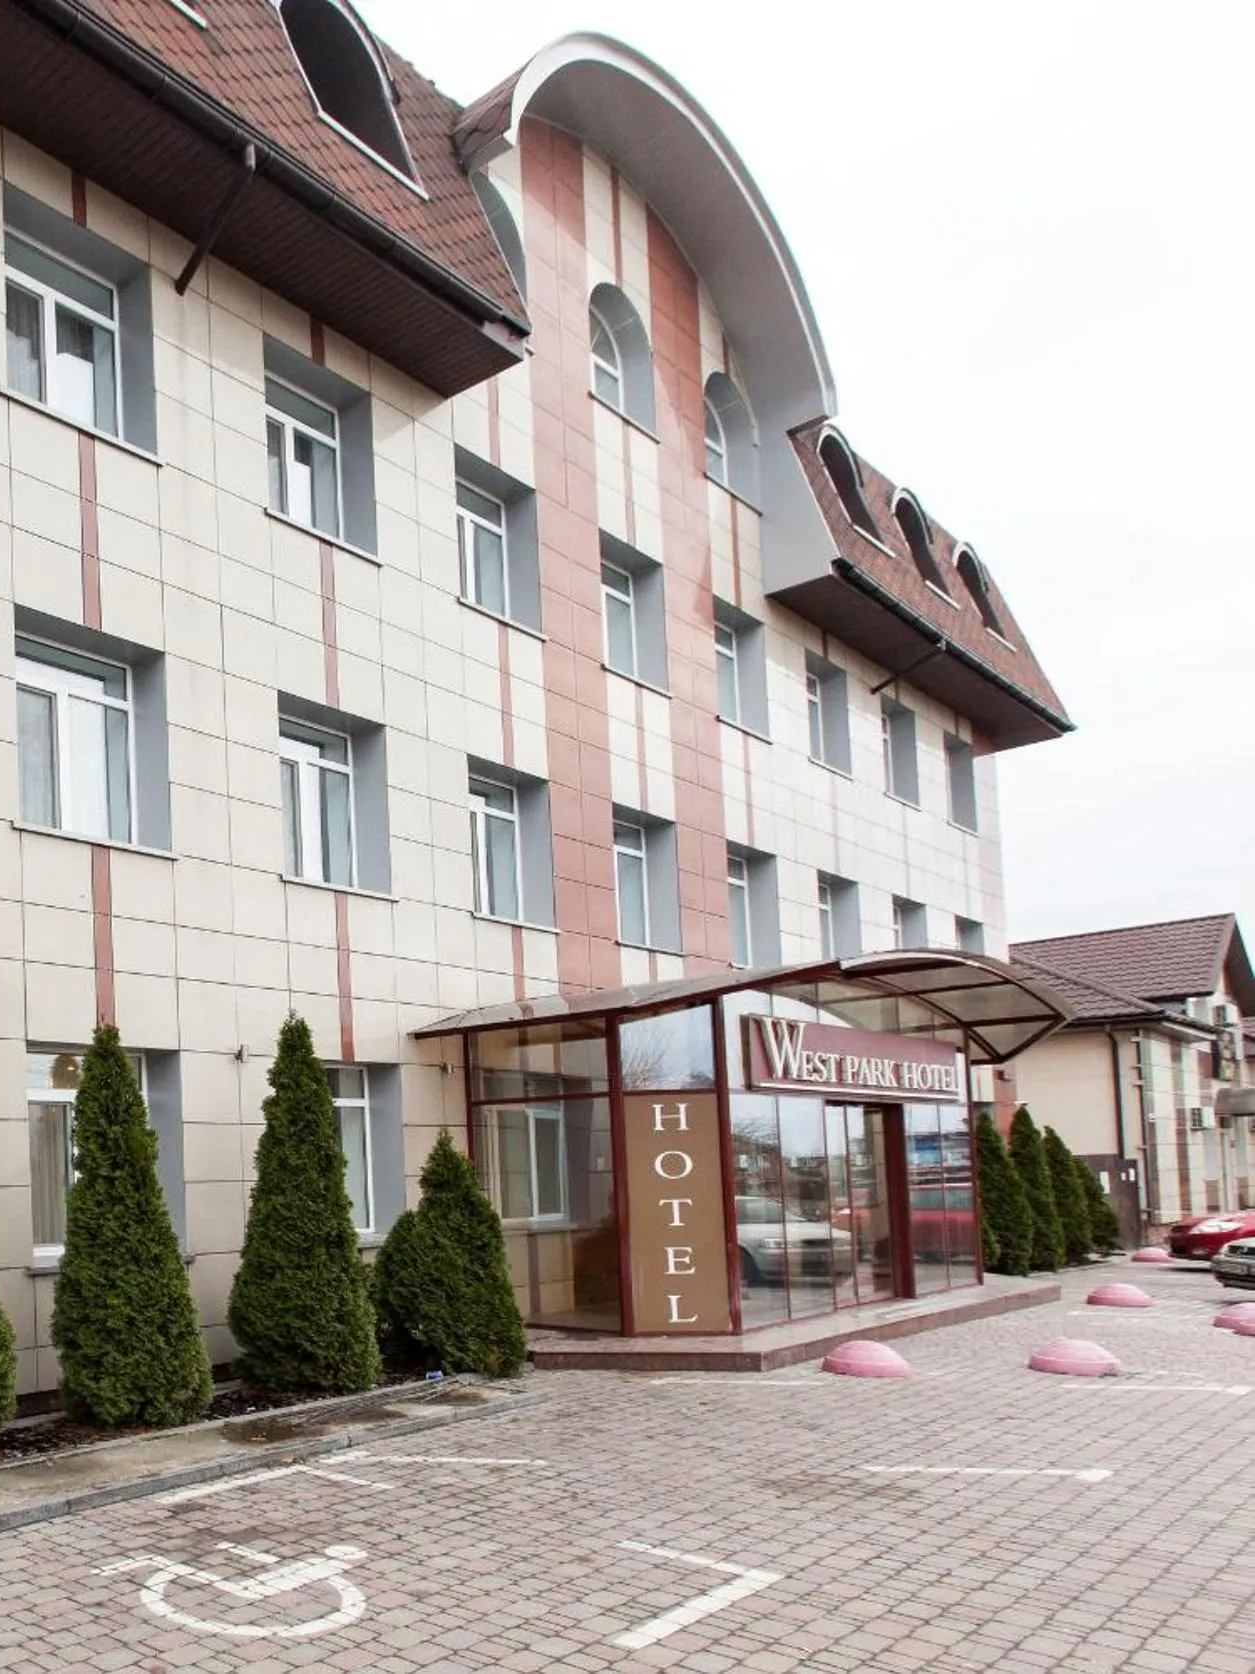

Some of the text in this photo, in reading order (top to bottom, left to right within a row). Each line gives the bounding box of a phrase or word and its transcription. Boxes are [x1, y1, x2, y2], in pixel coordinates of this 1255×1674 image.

[755, 1014, 959, 1092] WEST PARK HOTEL
[652, 1103, 698, 1323] HOTEL
